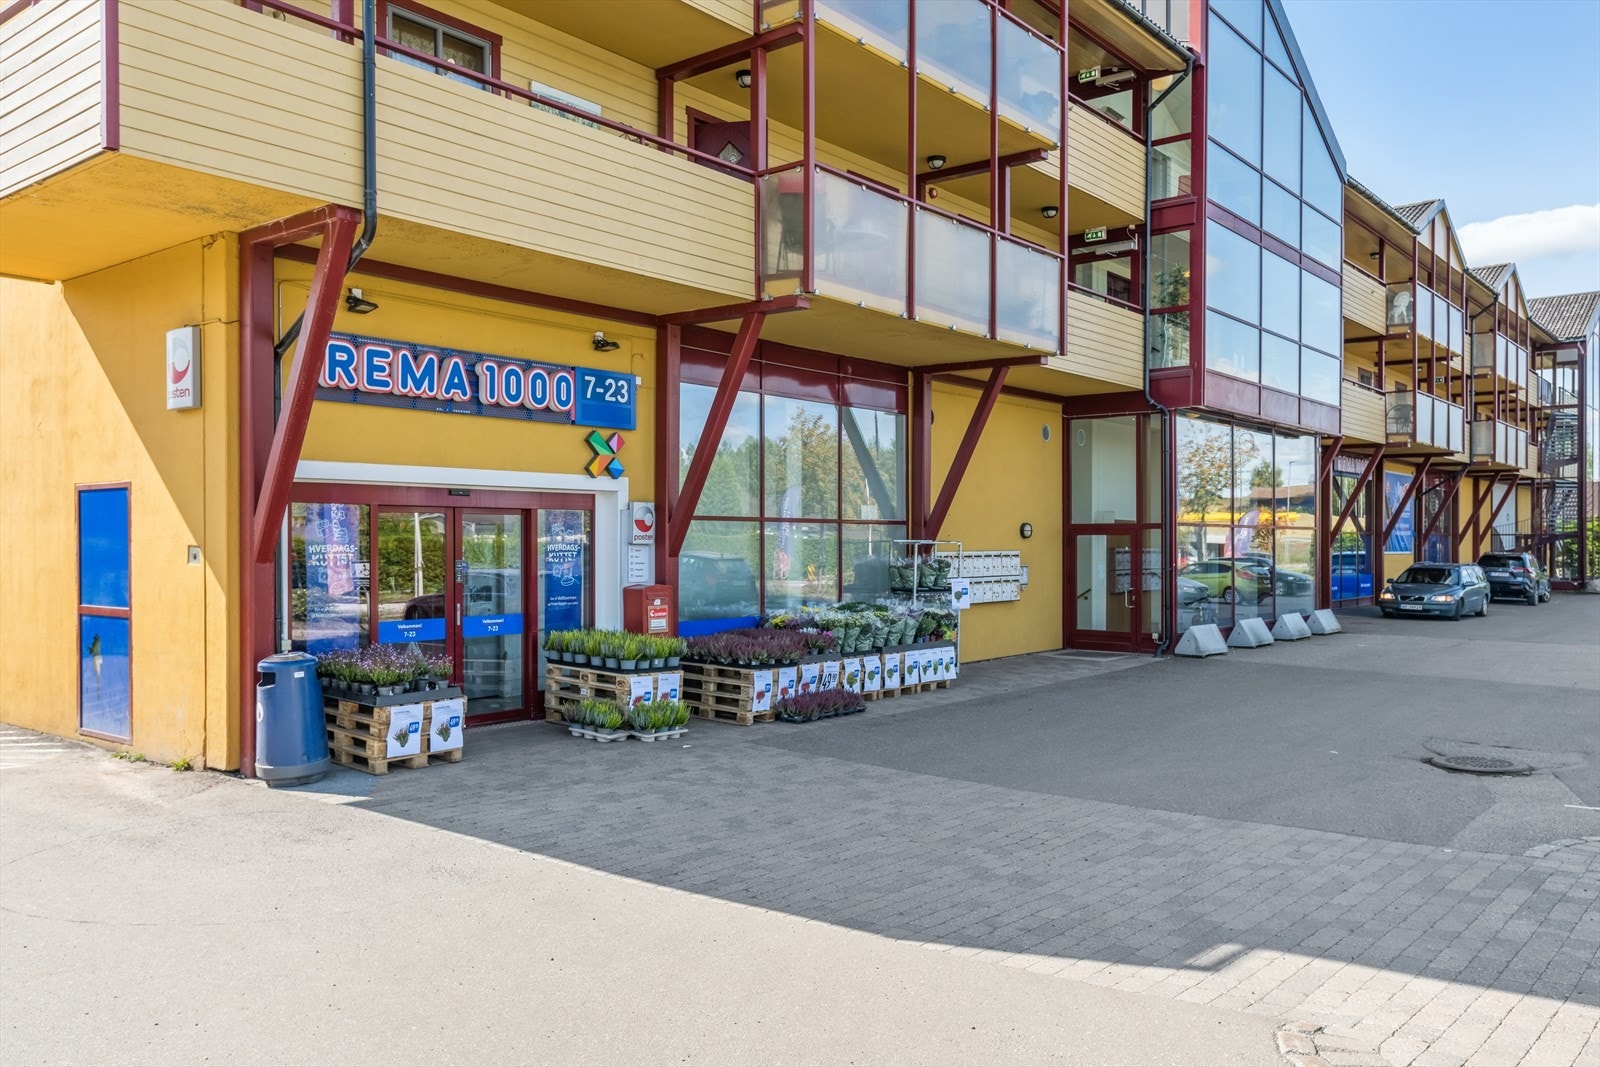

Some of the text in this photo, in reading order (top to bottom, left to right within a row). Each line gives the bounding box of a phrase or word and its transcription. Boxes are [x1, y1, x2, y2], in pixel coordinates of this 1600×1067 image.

[324, 339, 574, 412] REMA 1000
[583, 375, 630, 404] 7-23
[308, 544, 359, 553] HVERDAGS-
[547, 543, 581, 551] HVERDAGS-
